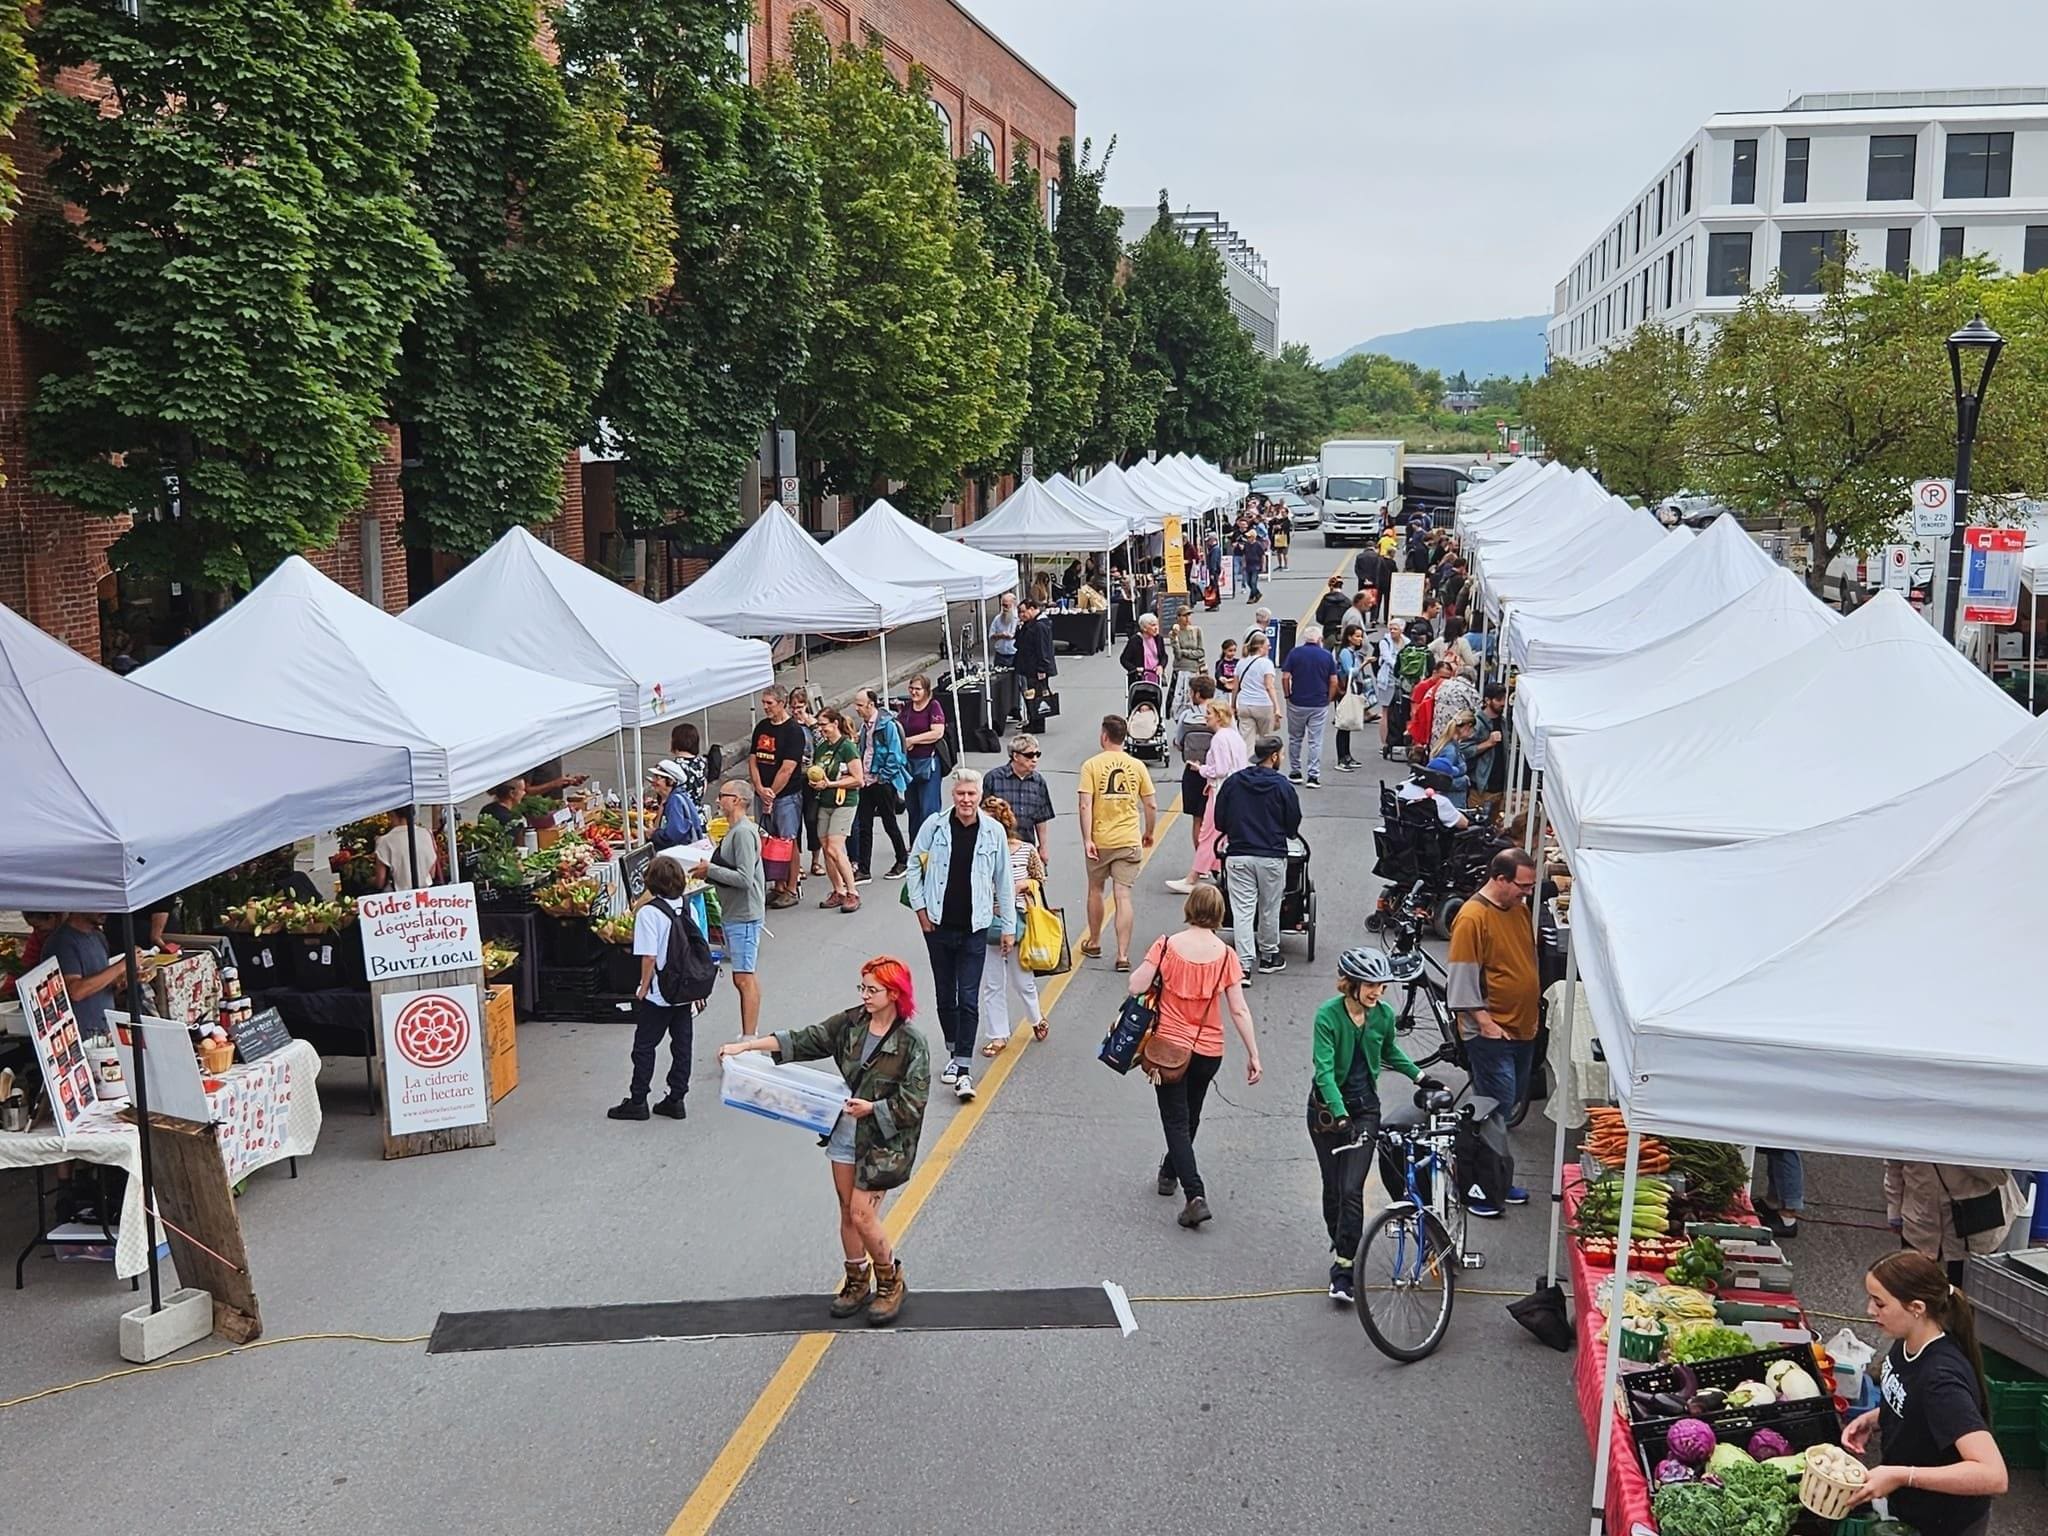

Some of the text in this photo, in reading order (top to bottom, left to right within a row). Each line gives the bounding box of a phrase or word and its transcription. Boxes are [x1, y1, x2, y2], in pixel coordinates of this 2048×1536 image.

[1974, 559, 1986, 568] 25
[363, 895, 412, 918] Cidre
[415, 891, 473, 909] Mercier
[374, 910, 464, 939] dégustation
[432, 950, 478, 966] LOCAL
[404, 1070, 469, 1089] La cidrerie
[402, 1087, 474, 1105] d'un hectare
